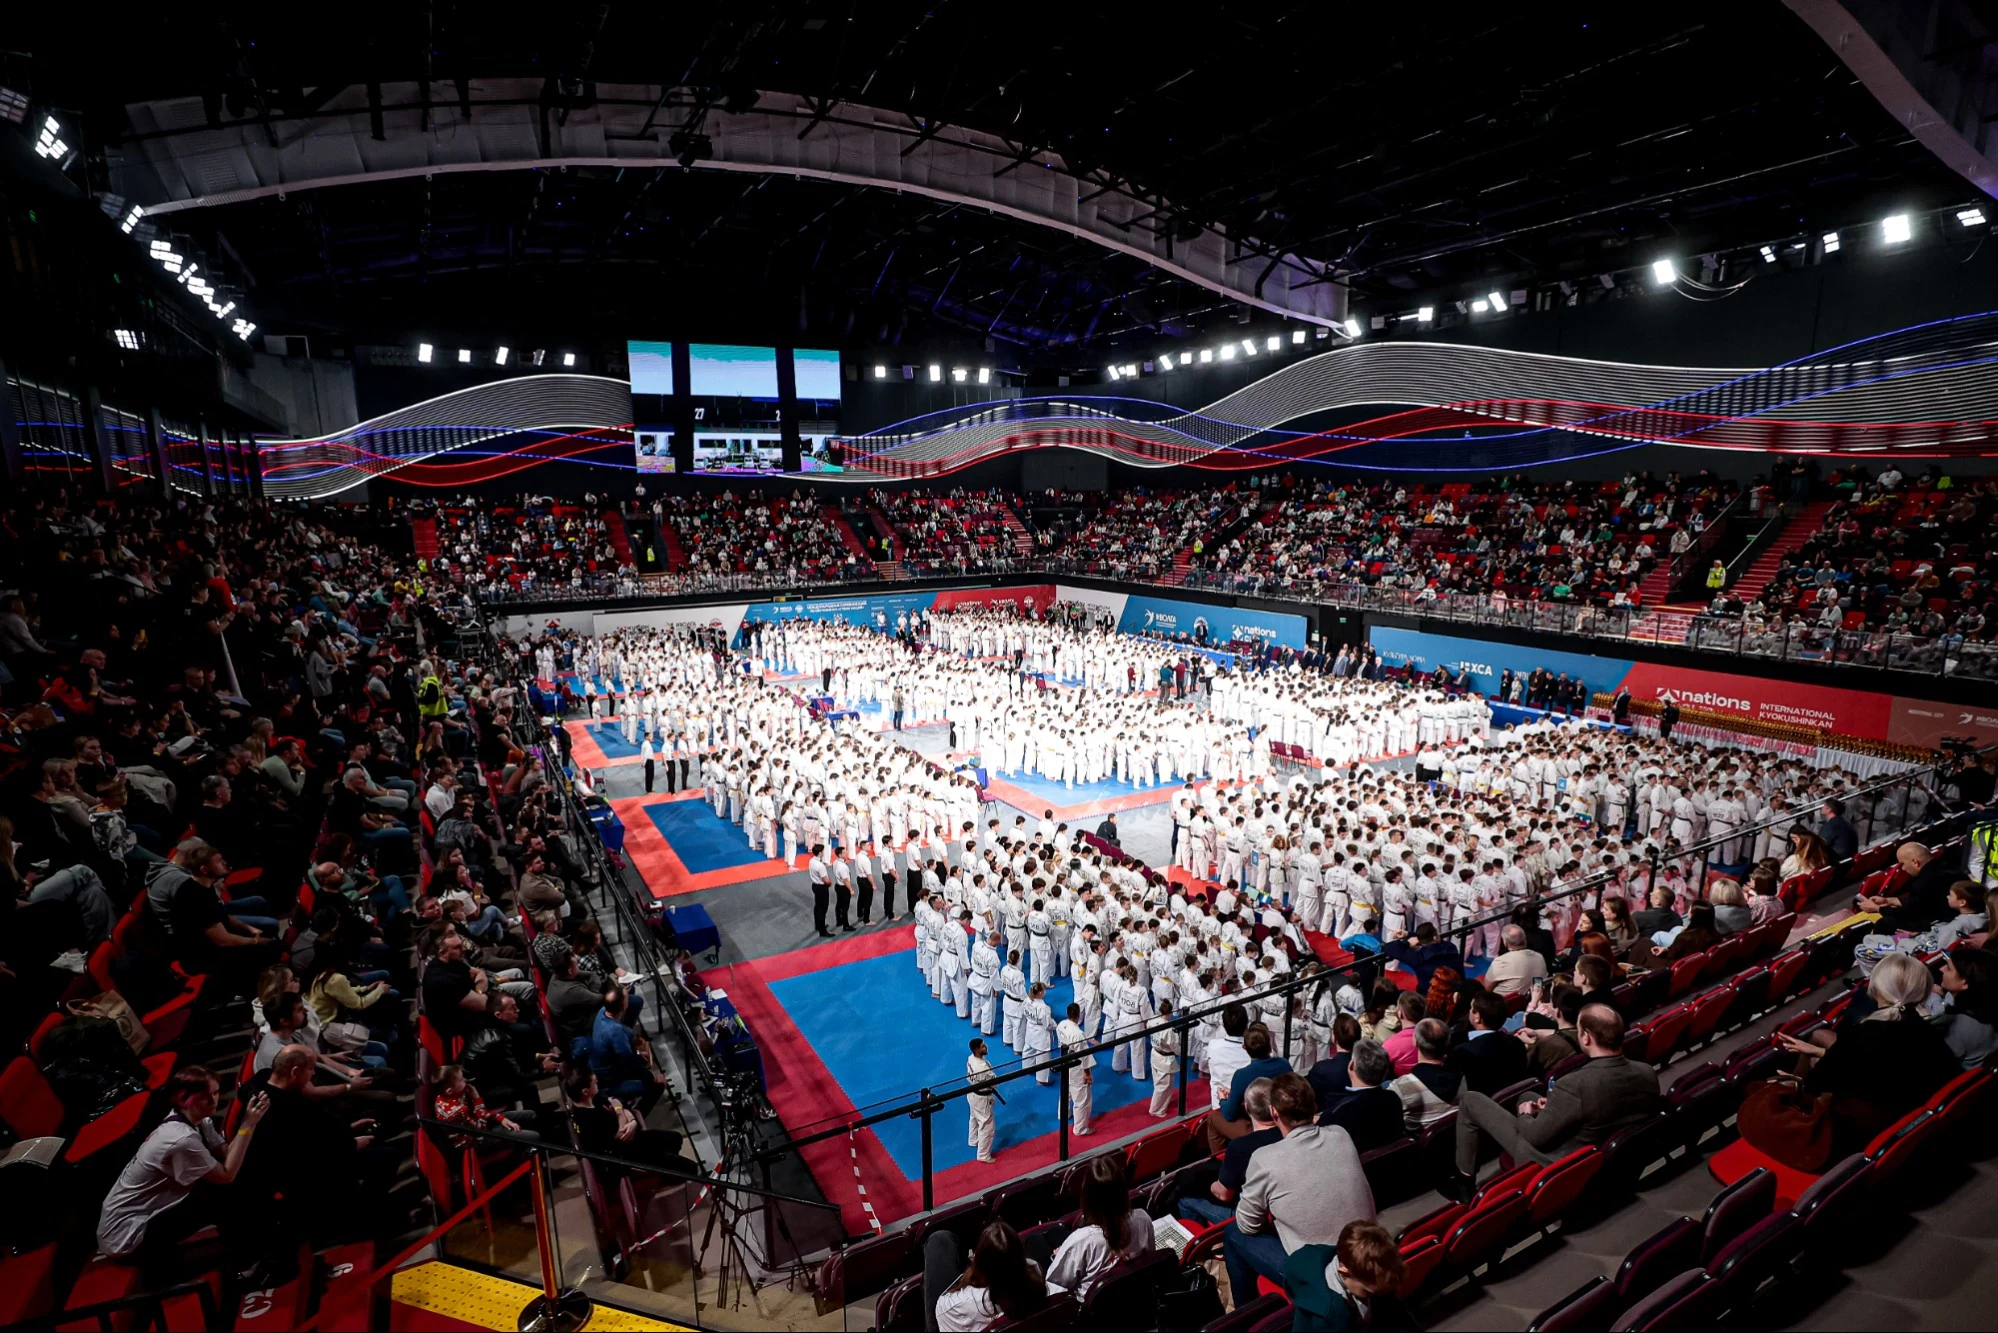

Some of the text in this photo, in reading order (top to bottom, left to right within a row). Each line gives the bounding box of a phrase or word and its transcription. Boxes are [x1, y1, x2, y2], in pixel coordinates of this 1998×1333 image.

[694, 408, 705, 420] 27
[1244, 624, 1277, 639] nations
[1681, 690, 1751, 711] nations
[1759, 711, 1833, 729] KYOKUSHINKAN
[1760, 703, 1836, 721] INTERNATIONAL
